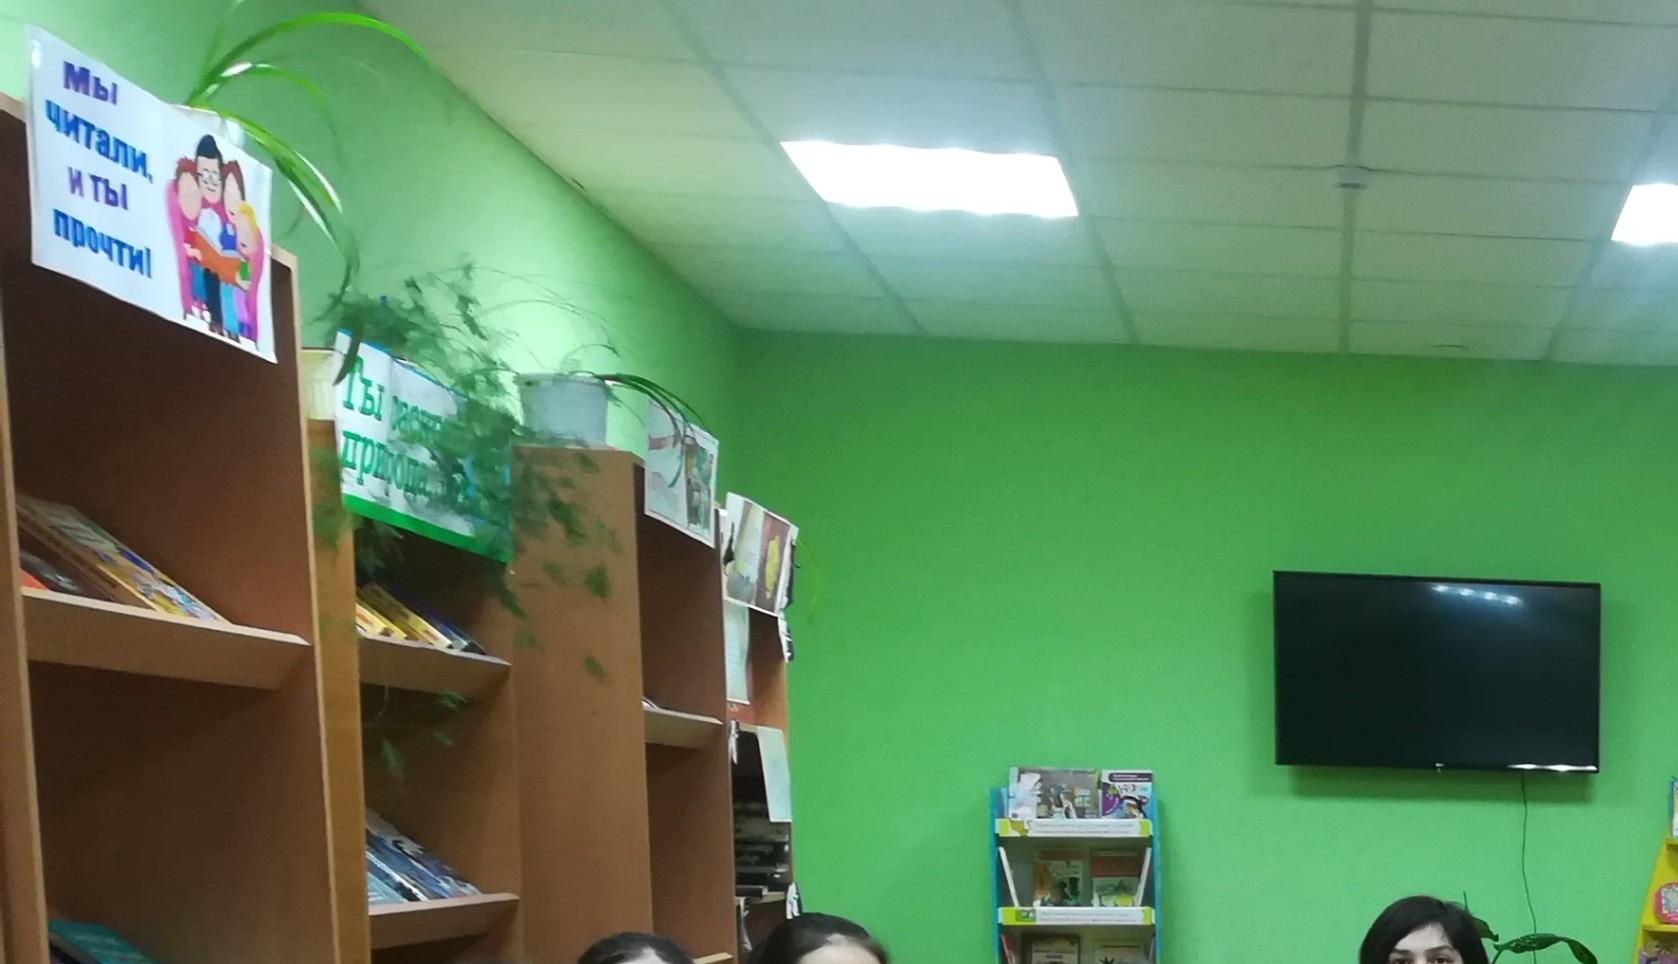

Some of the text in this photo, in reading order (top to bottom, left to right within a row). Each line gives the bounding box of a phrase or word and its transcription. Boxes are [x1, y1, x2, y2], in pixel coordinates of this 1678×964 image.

[63, 60, 118, 106] Мы
[45, 99, 153, 184] читали,
[90, 172, 129, 211] ты
[53, 208, 153, 279] прочти!
